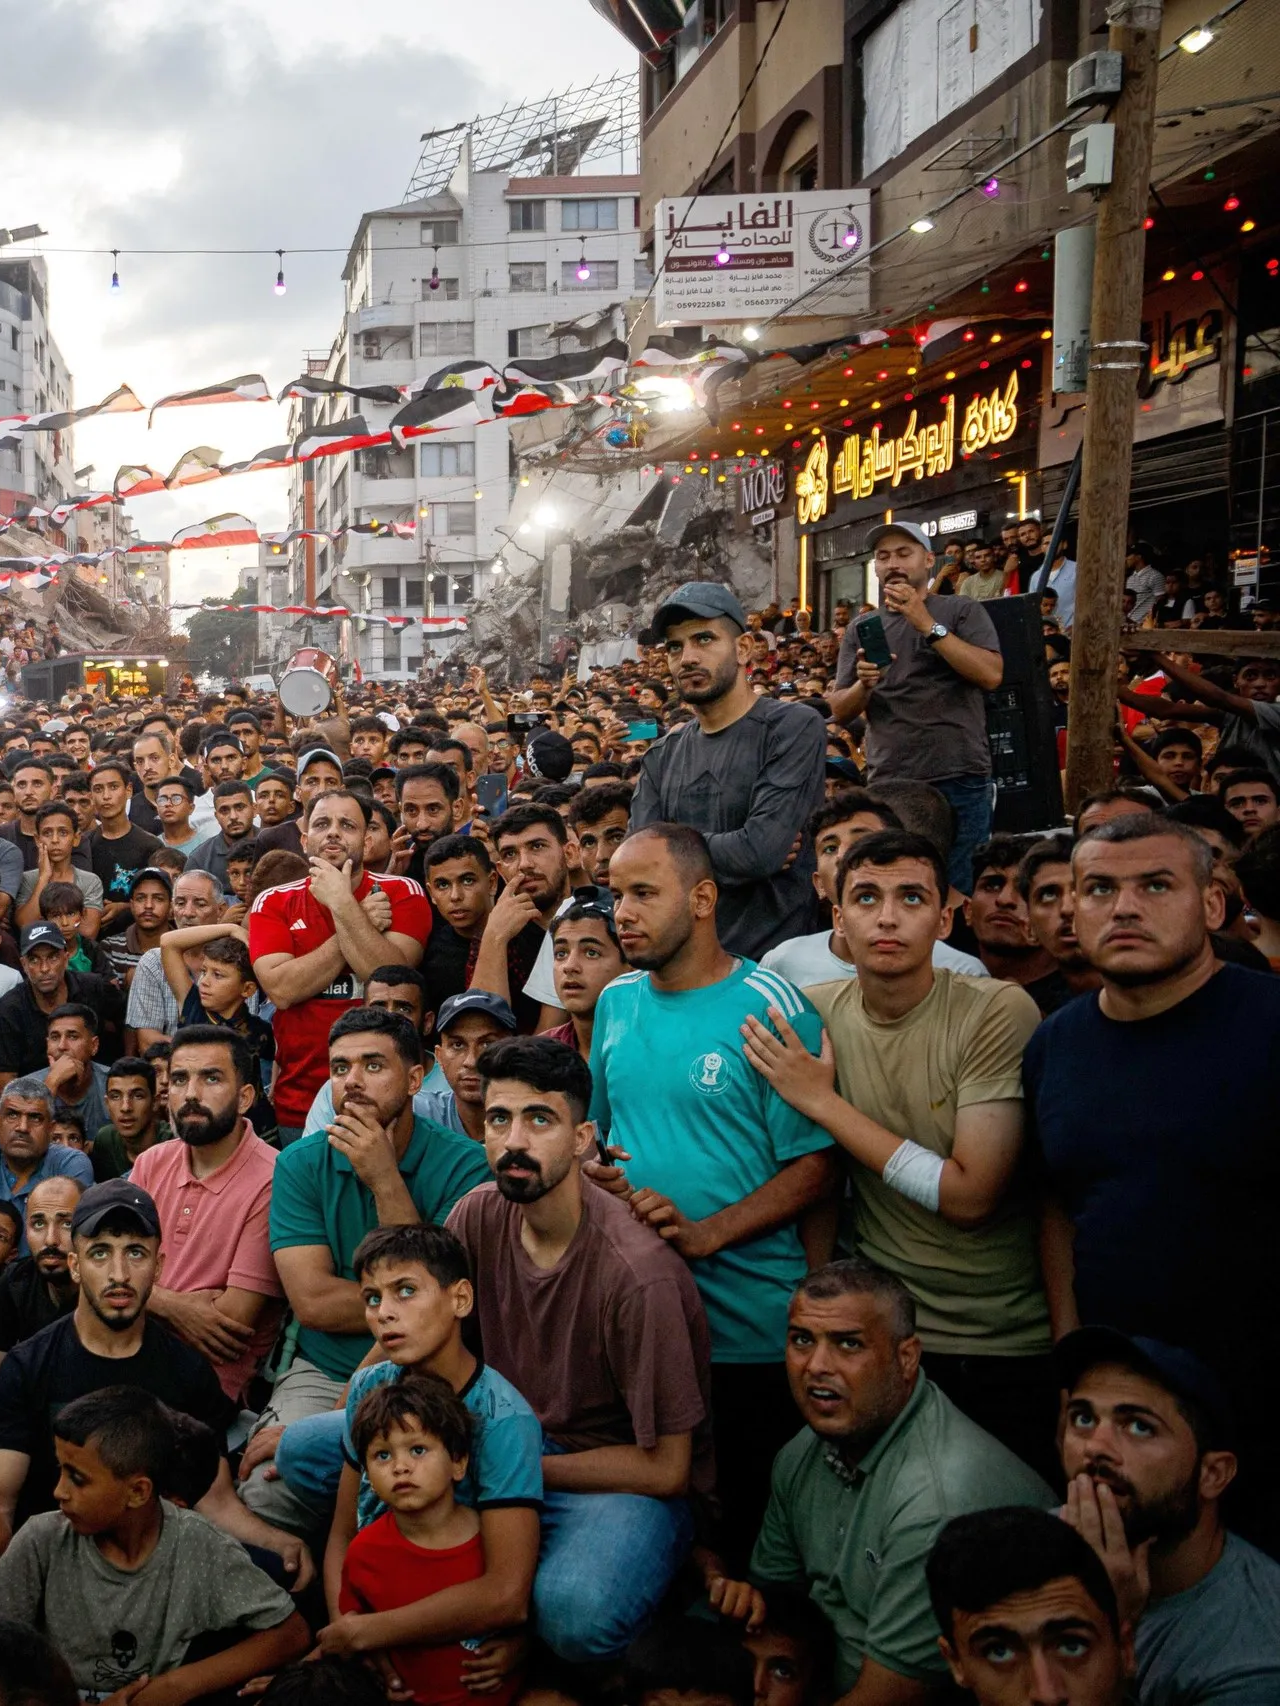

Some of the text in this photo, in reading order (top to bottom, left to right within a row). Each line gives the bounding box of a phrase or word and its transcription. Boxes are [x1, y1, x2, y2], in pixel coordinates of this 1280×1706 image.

[664, 200, 793, 240] الفايز
[672, 230, 792, 249] للمحاماة
[741, 459, 785, 514] MORE
